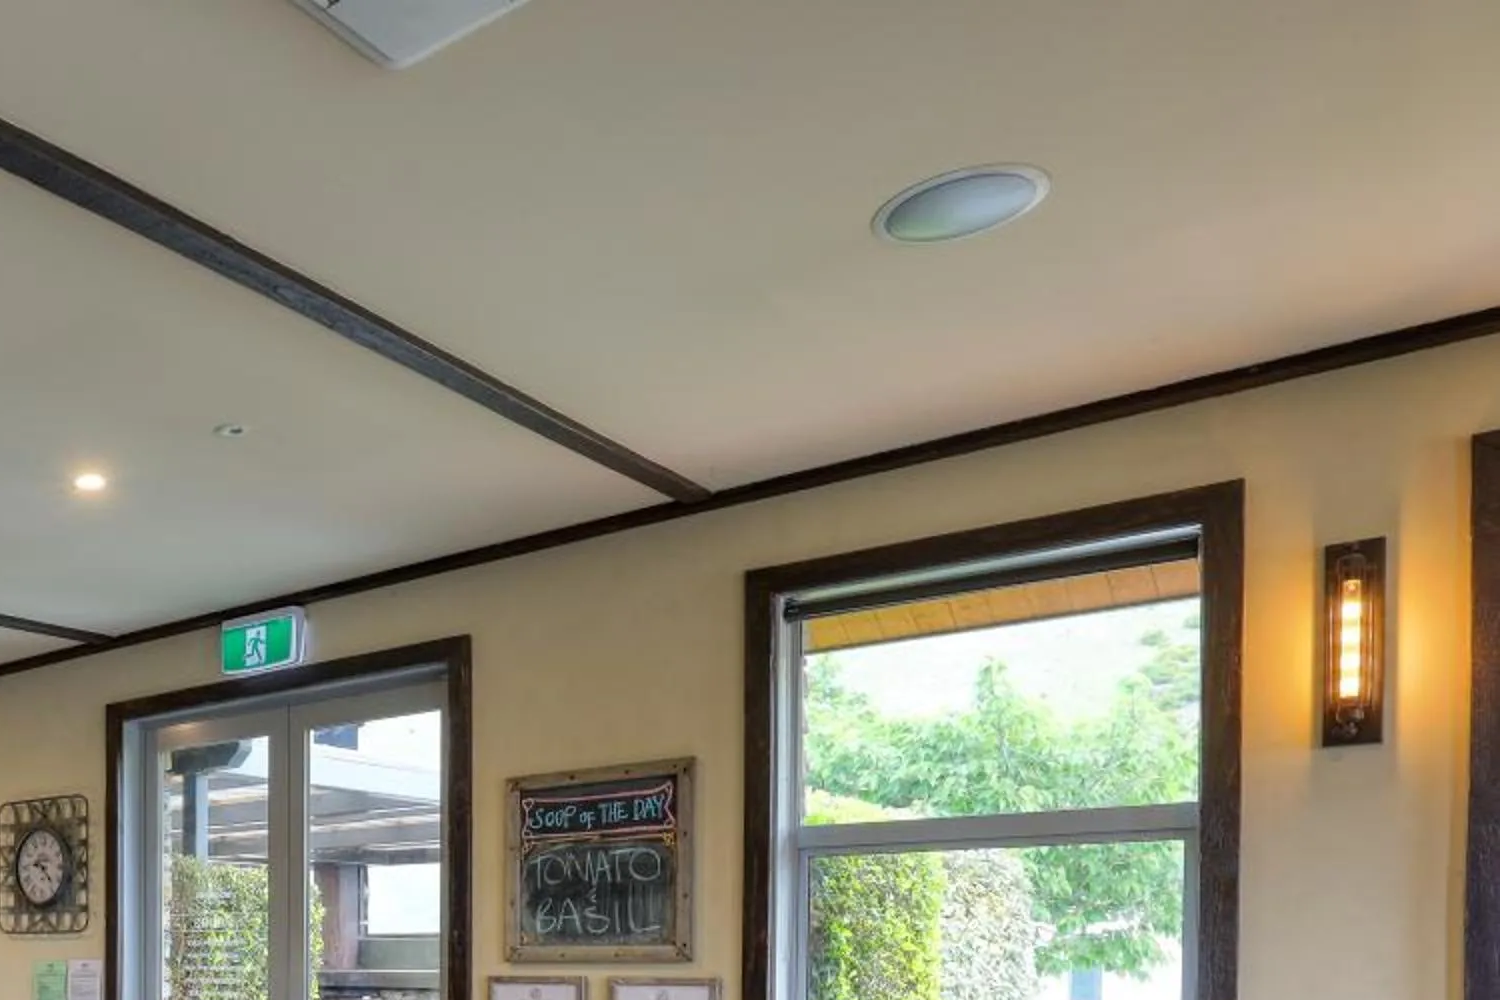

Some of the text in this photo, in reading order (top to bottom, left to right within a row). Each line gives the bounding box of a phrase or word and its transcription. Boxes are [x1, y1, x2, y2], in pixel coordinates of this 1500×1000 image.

[530, 795, 665, 829] SOUP OF THE DAY
[530, 848, 661, 889] TOMATO
[536, 888, 661, 934] BASIL
